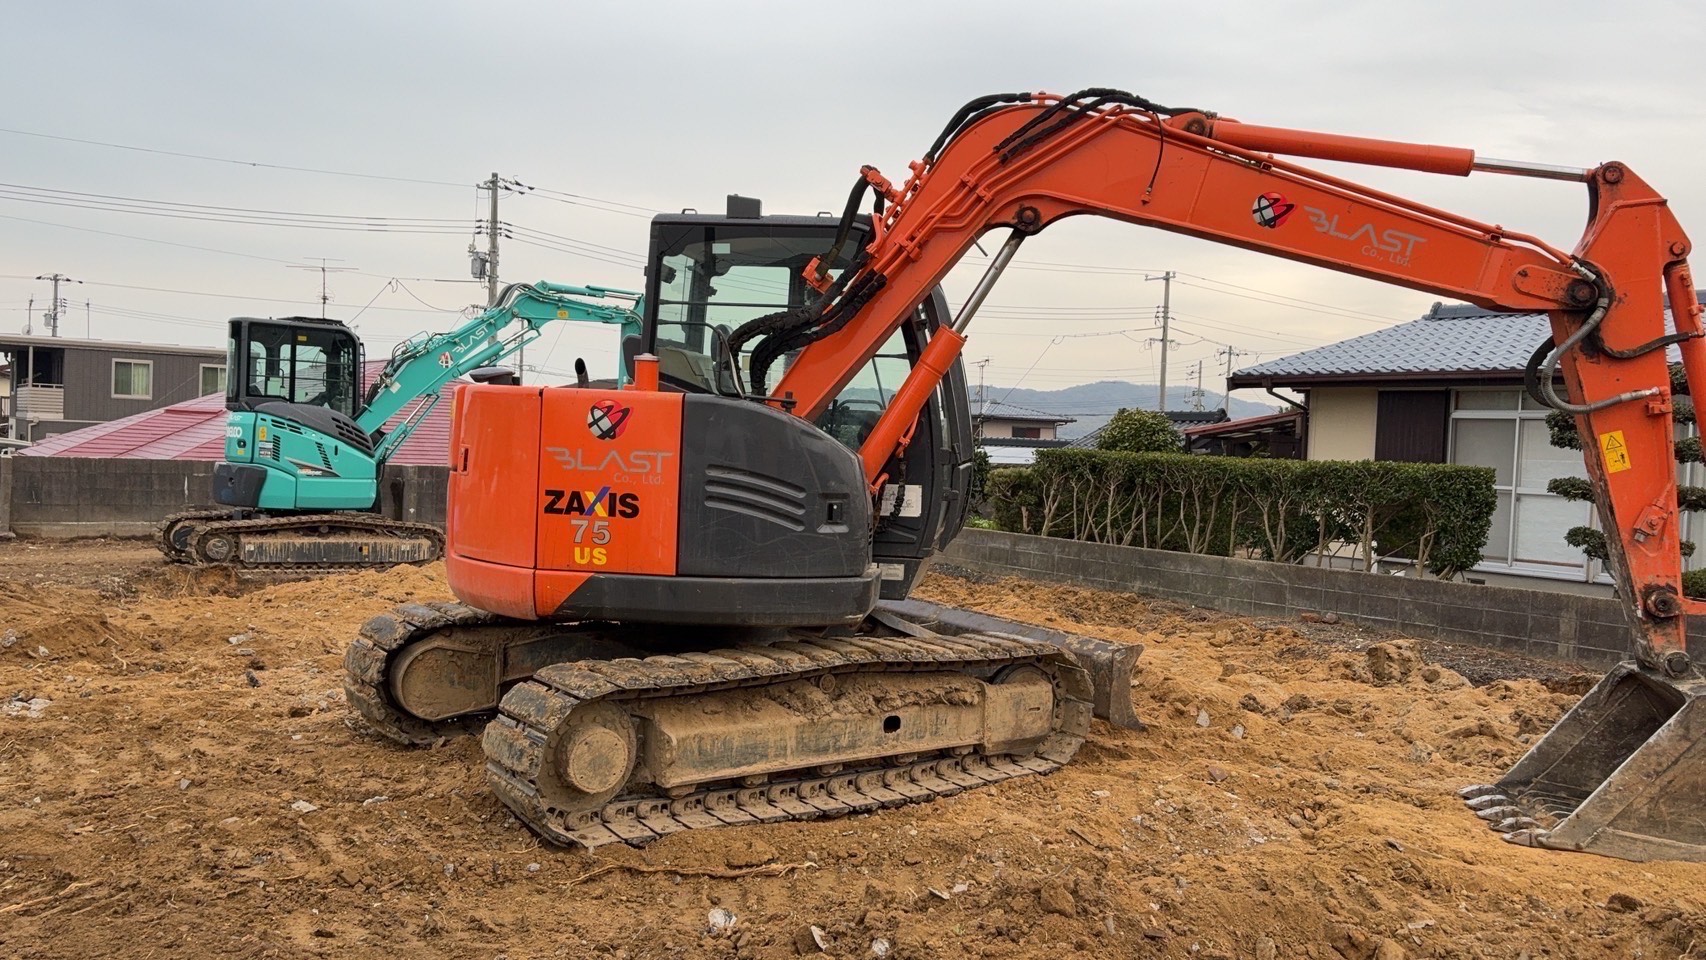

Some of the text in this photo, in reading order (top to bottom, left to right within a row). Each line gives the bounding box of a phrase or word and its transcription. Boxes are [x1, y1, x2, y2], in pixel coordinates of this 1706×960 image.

[1303, 205, 1428, 256] BLAST
[1389, 252, 1411, 267] Ltd.
[452, 325, 488, 353] BLAST
[545, 447, 673, 473] BLAST
[643, 474, 664, 485] Ltd.
[544, 486, 640, 519] ZAXIS
[570, 519, 612, 545] 75
[574, 547, 607, 565] US
